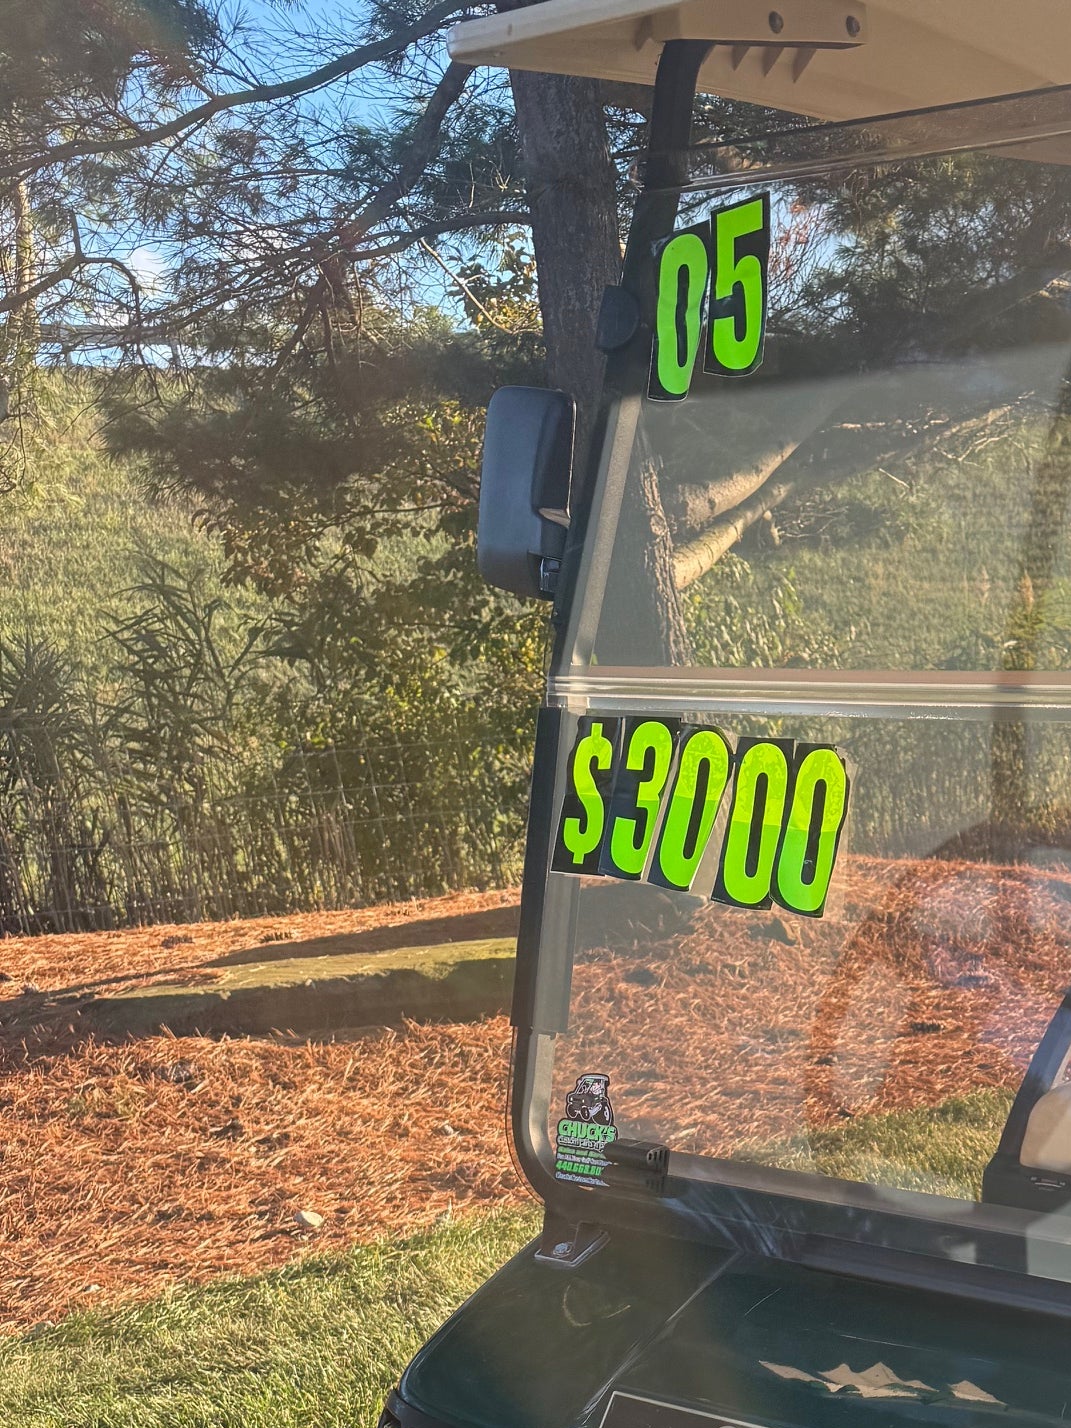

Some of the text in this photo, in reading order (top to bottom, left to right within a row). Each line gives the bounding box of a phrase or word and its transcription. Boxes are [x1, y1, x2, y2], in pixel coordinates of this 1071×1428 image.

[656, 198, 764, 395] 05
[563, 721, 847, 912] $3000
[558, 1119, 617, 1142] CHUCK'S
